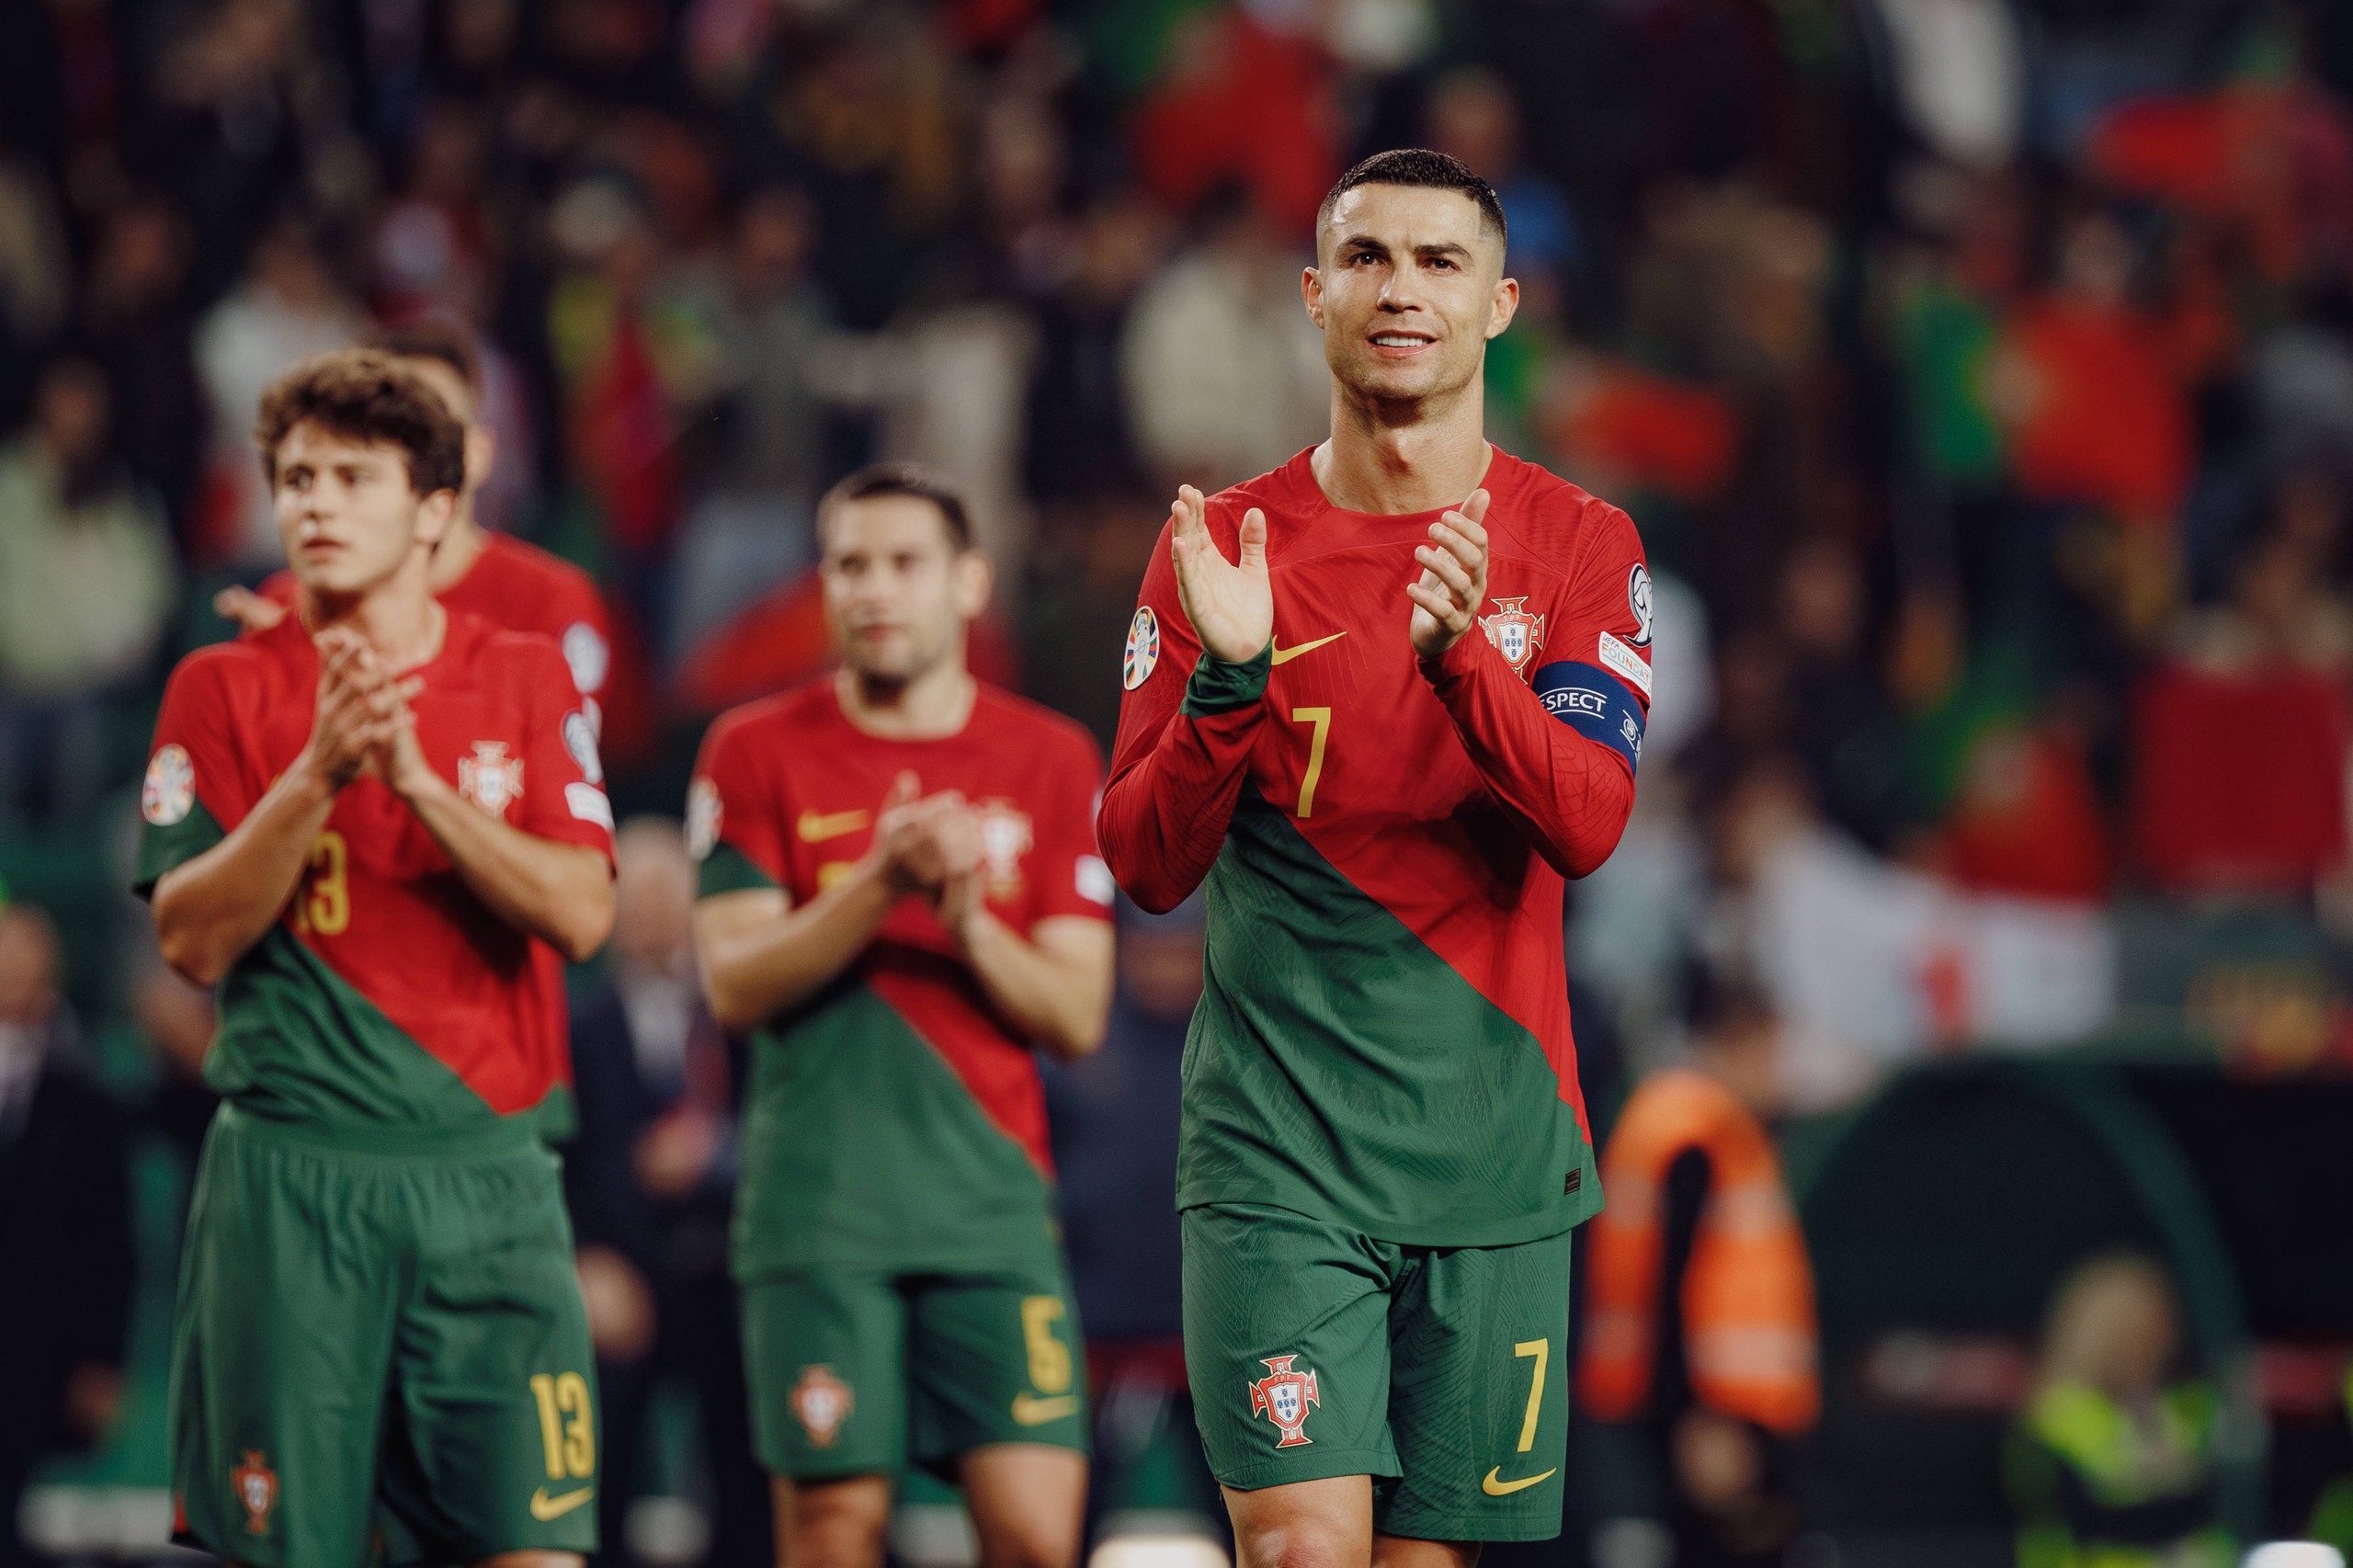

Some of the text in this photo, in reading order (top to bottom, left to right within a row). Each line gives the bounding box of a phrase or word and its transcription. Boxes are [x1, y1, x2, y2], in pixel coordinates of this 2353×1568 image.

[1602, 634, 1620, 649] UEFA
[1540, 692, 1607, 712] SPECT
[1292, 707, 1331, 818] 7
[1021, 1295, 1072, 1394] 5
[1515, 1338, 1549, 1452] 7
[529, 1371, 596, 1480] 13
